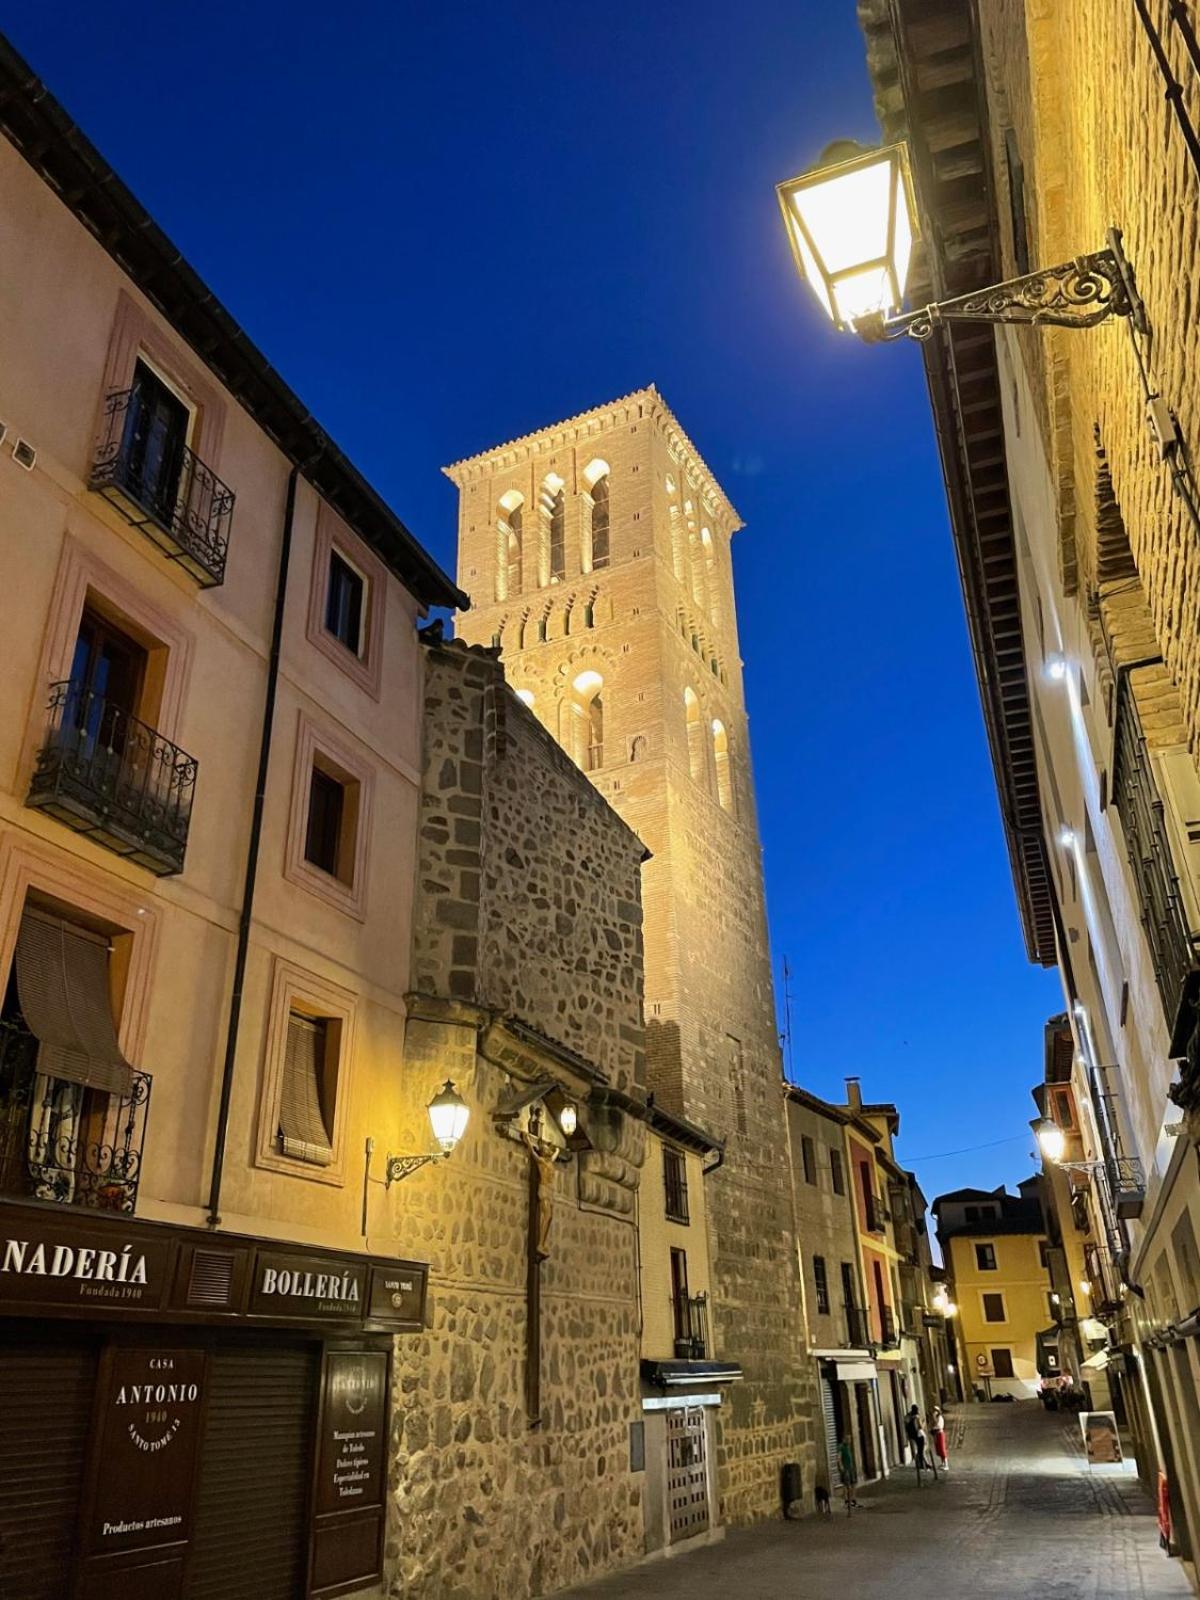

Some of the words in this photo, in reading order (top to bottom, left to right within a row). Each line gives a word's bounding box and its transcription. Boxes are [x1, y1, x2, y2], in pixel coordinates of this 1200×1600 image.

[1, 1239, 148, 1284] NADERÍA
[262, 1268, 359, 1301] BOLLERÍA
[149, 1358, 174, 1369] CASA
[115, 1384, 198, 1404] ANTONIO
[102, 1520, 144, 1536] Productos
[145, 1515, 182, 1529] artesanos
